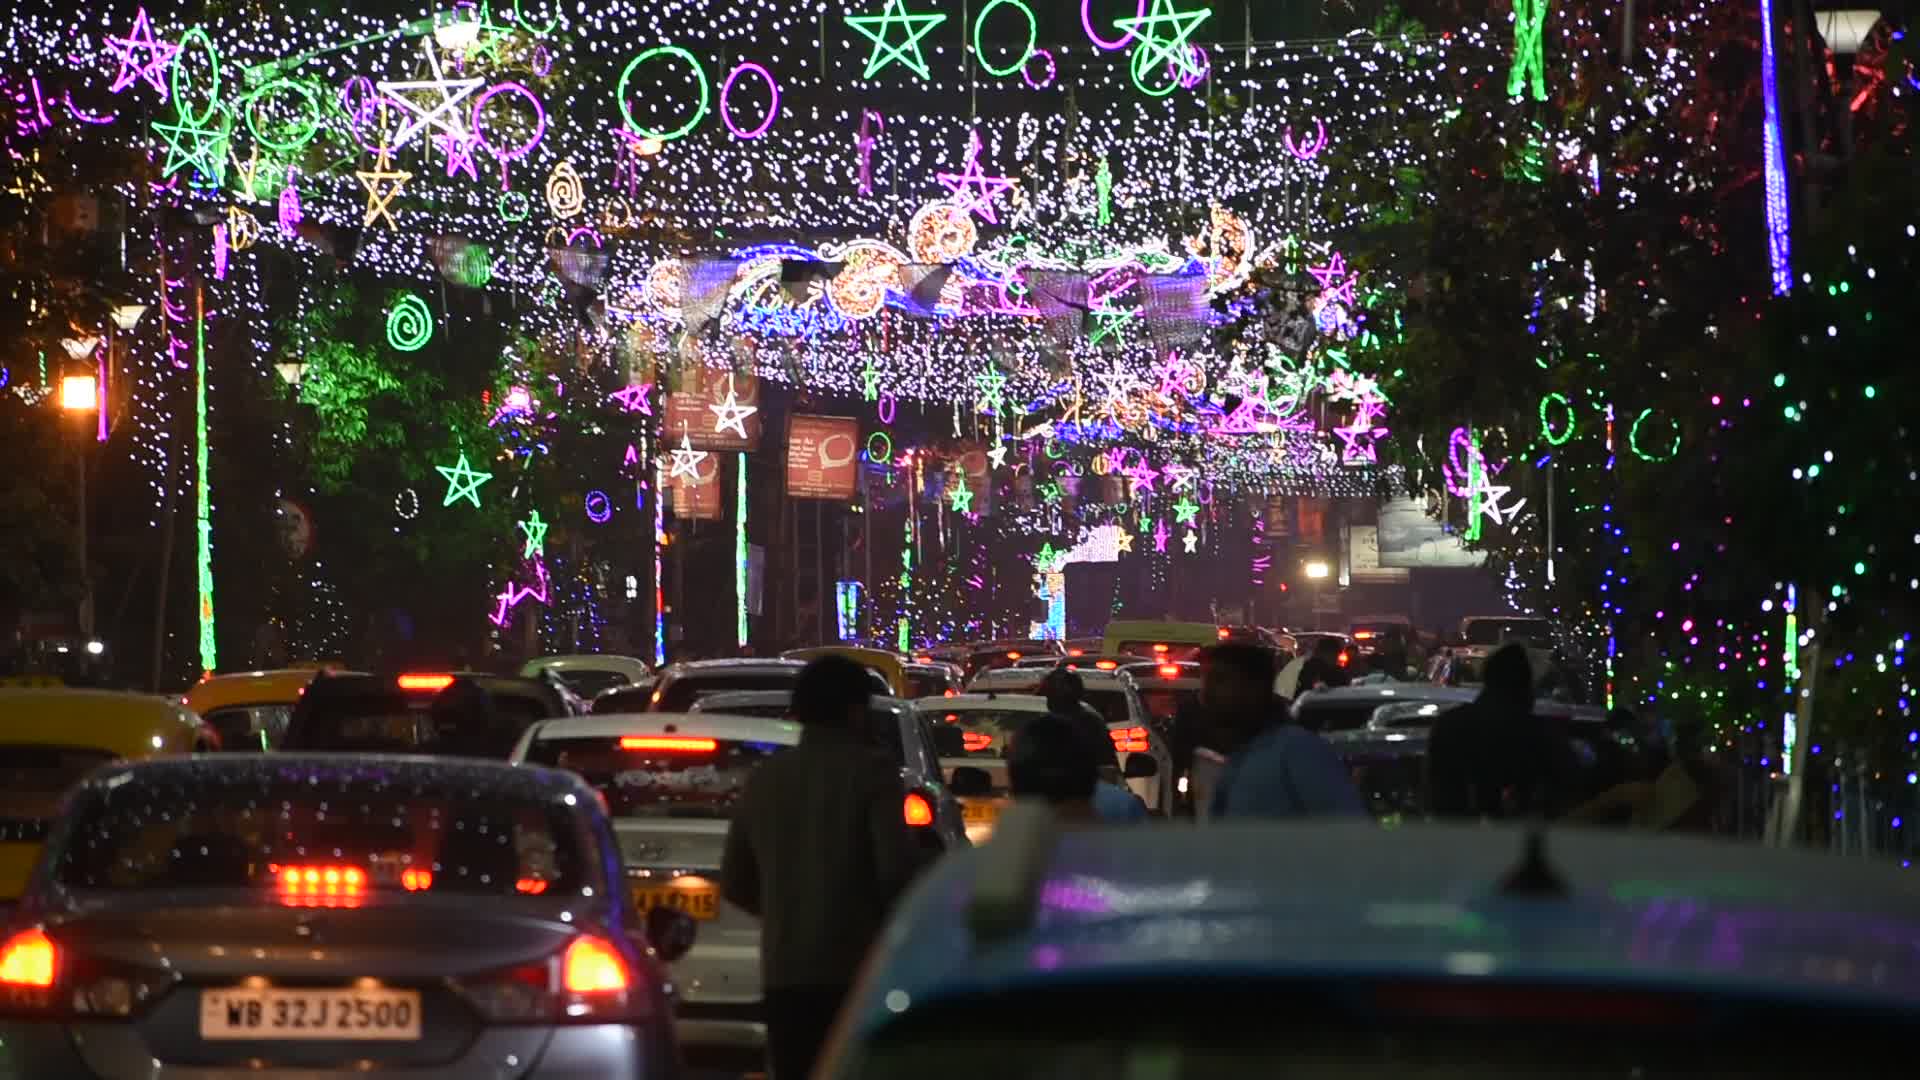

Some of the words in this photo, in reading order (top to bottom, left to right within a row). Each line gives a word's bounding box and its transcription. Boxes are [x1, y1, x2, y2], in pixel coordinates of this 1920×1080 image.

[226, 998, 263, 1028] WB
[271, 998, 328, 1028] 32J
[337, 998, 412, 1028] 2500
